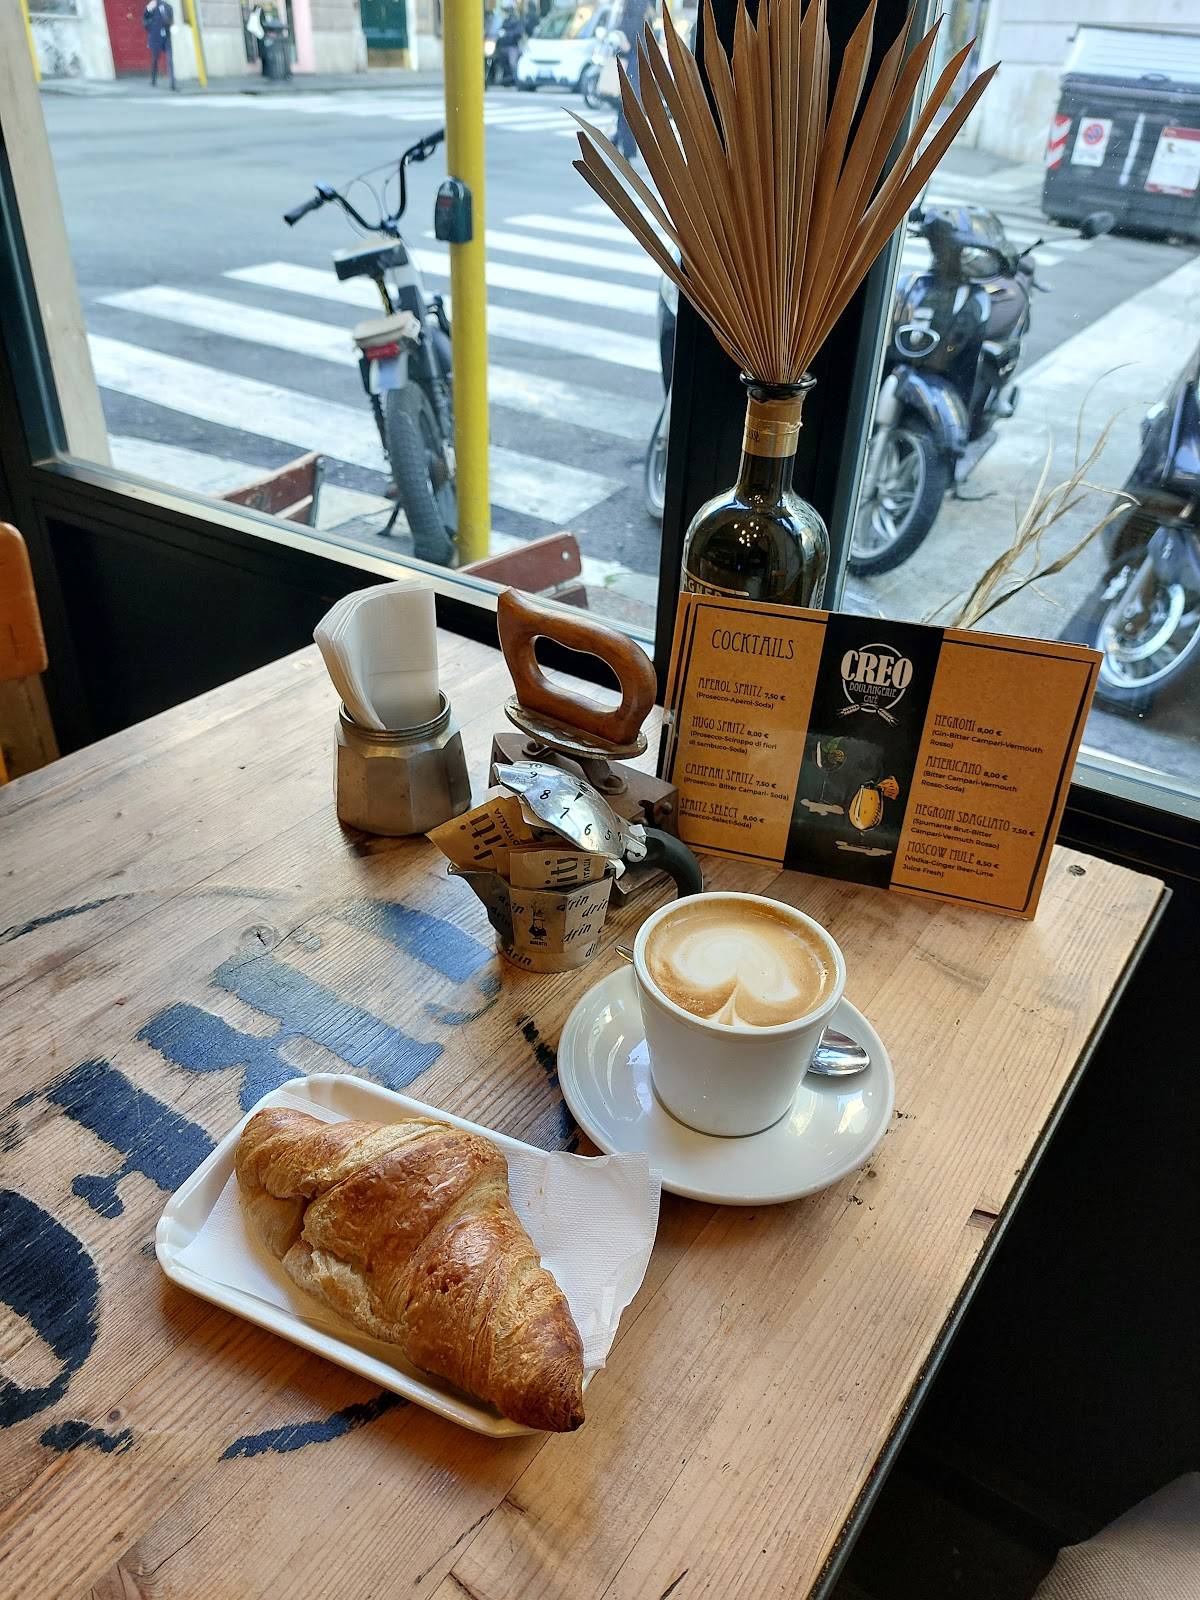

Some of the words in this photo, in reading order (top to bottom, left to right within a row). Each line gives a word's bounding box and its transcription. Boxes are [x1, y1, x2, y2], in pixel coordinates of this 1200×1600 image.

[711, 629, 794, 659] COCKTAILS
[840, 649, 913, 689] CREO
[698, 677, 730, 693] APEROL
[733, 682, 762, 698] SPRITZ
[764, 692, 779, 701] 7,50
[849, 682, 897, 697] BOULANGERIE
[692, 715, 715, 730] HUGO
[717, 720, 745, 735] SPRITZ
[934, 714, 976, 732] NEGRONI
[977, 727, 994, 735] 8,00
[755, 739, 762, 747] di
[763, 741, 777, 750] fiori
[930, 739, 954, 749] Rosso)
[932, 729, 969, 741] (Gin-Bitter
[971, 736, 1043, 754] Campari-Vermouth
[685, 763, 724, 780] CAMPARI
[726, 769, 754, 785] SPRITZ
[925, 755, 982, 776] AMERICANO
[983, 771, 1000, 779] 8,00
[719, 782, 737, 791] Bitter
[770, 792, 789, 801] Soda)
[921, 779, 965, 793] Rosso-Soda)
[923, 770, 946, 780] (Bitter
[947, 774, 1017, 793] Campari-Vermouth
[540, 789, 551, 800] 8
[560, 807, 570, 819] 7
[680, 798, 708, 813] SPRITZ
[709, 802, 739, 819] SELECT
[912, 818, 952, 830] (Spumante
[915, 803, 956, 821] NEGRONI
[956, 811, 1010, 831] SBAGLIATO
[1012, 826, 1027, 835] 7,50
[584, 823, 593, 836] 6
[604, 829, 612, 840] 5
[906, 840, 947, 858] MOSCOW
[949, 849, 975, 864] MULE
[976, 860, 992, 868] 8,50
[975, 839, 1000, 850] Rosso)
[902, 863, 921, 872] Juice
[923, 867, 944, 878] Fresh)
[904, 855, 955, 869] (Vodka-Ginger
[956, 865, 994, 878] Beer-Lime
[561, 923, 592, 943] drin
